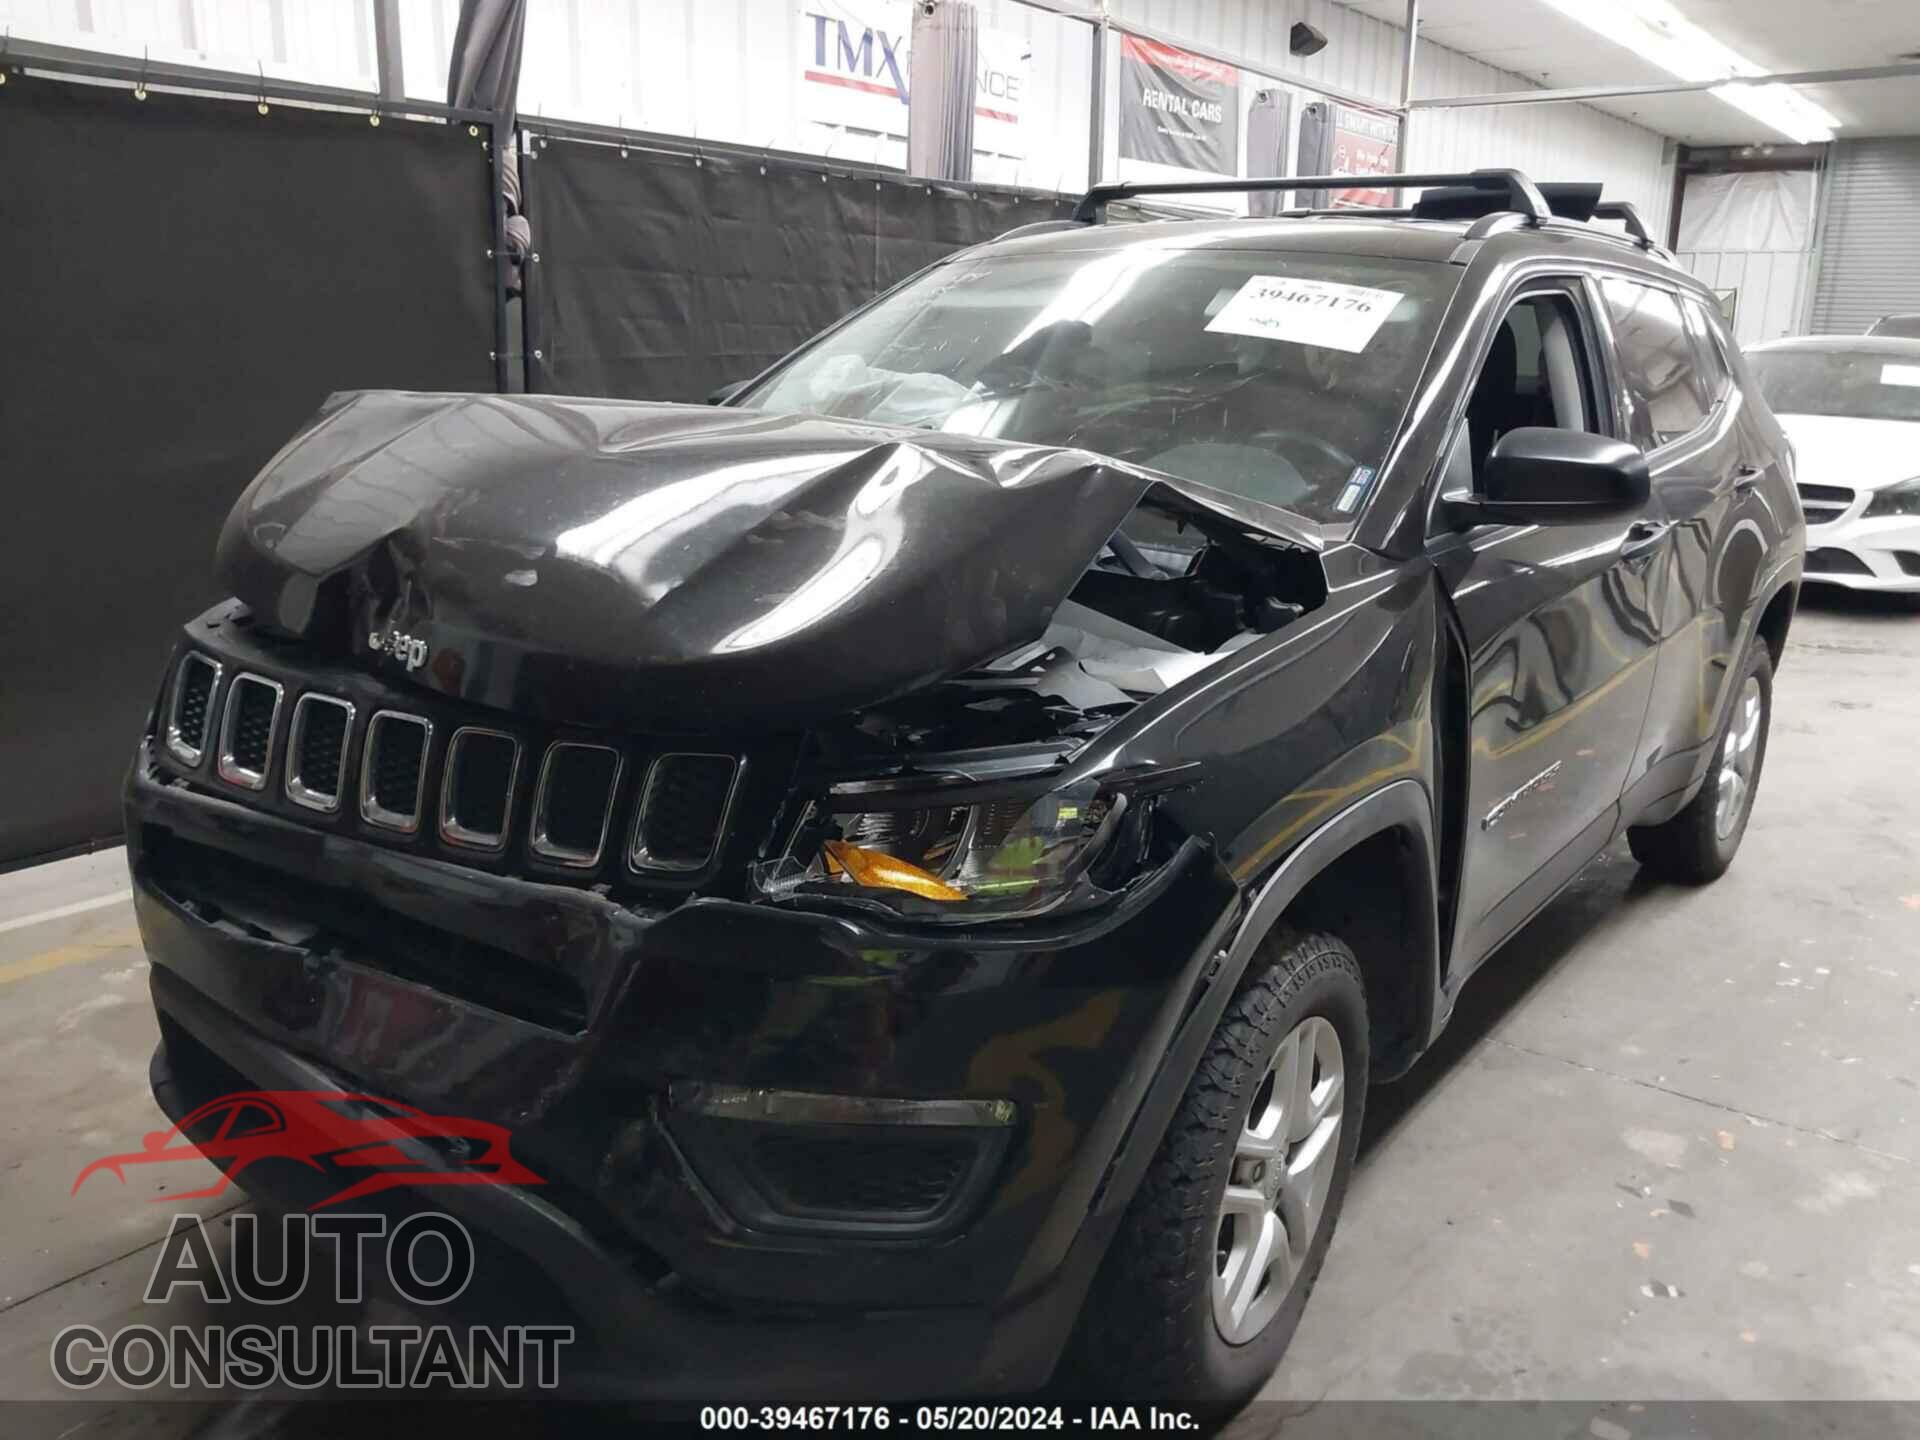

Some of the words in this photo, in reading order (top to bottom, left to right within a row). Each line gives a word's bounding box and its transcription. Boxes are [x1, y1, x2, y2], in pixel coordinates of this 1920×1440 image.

[805, 12, 909, 105] TMX
[976, 69, 1019, 102] NCE
[1142, 87, 1189, 116] RENTAL
[1191, 99, 1223, 123] CARS
